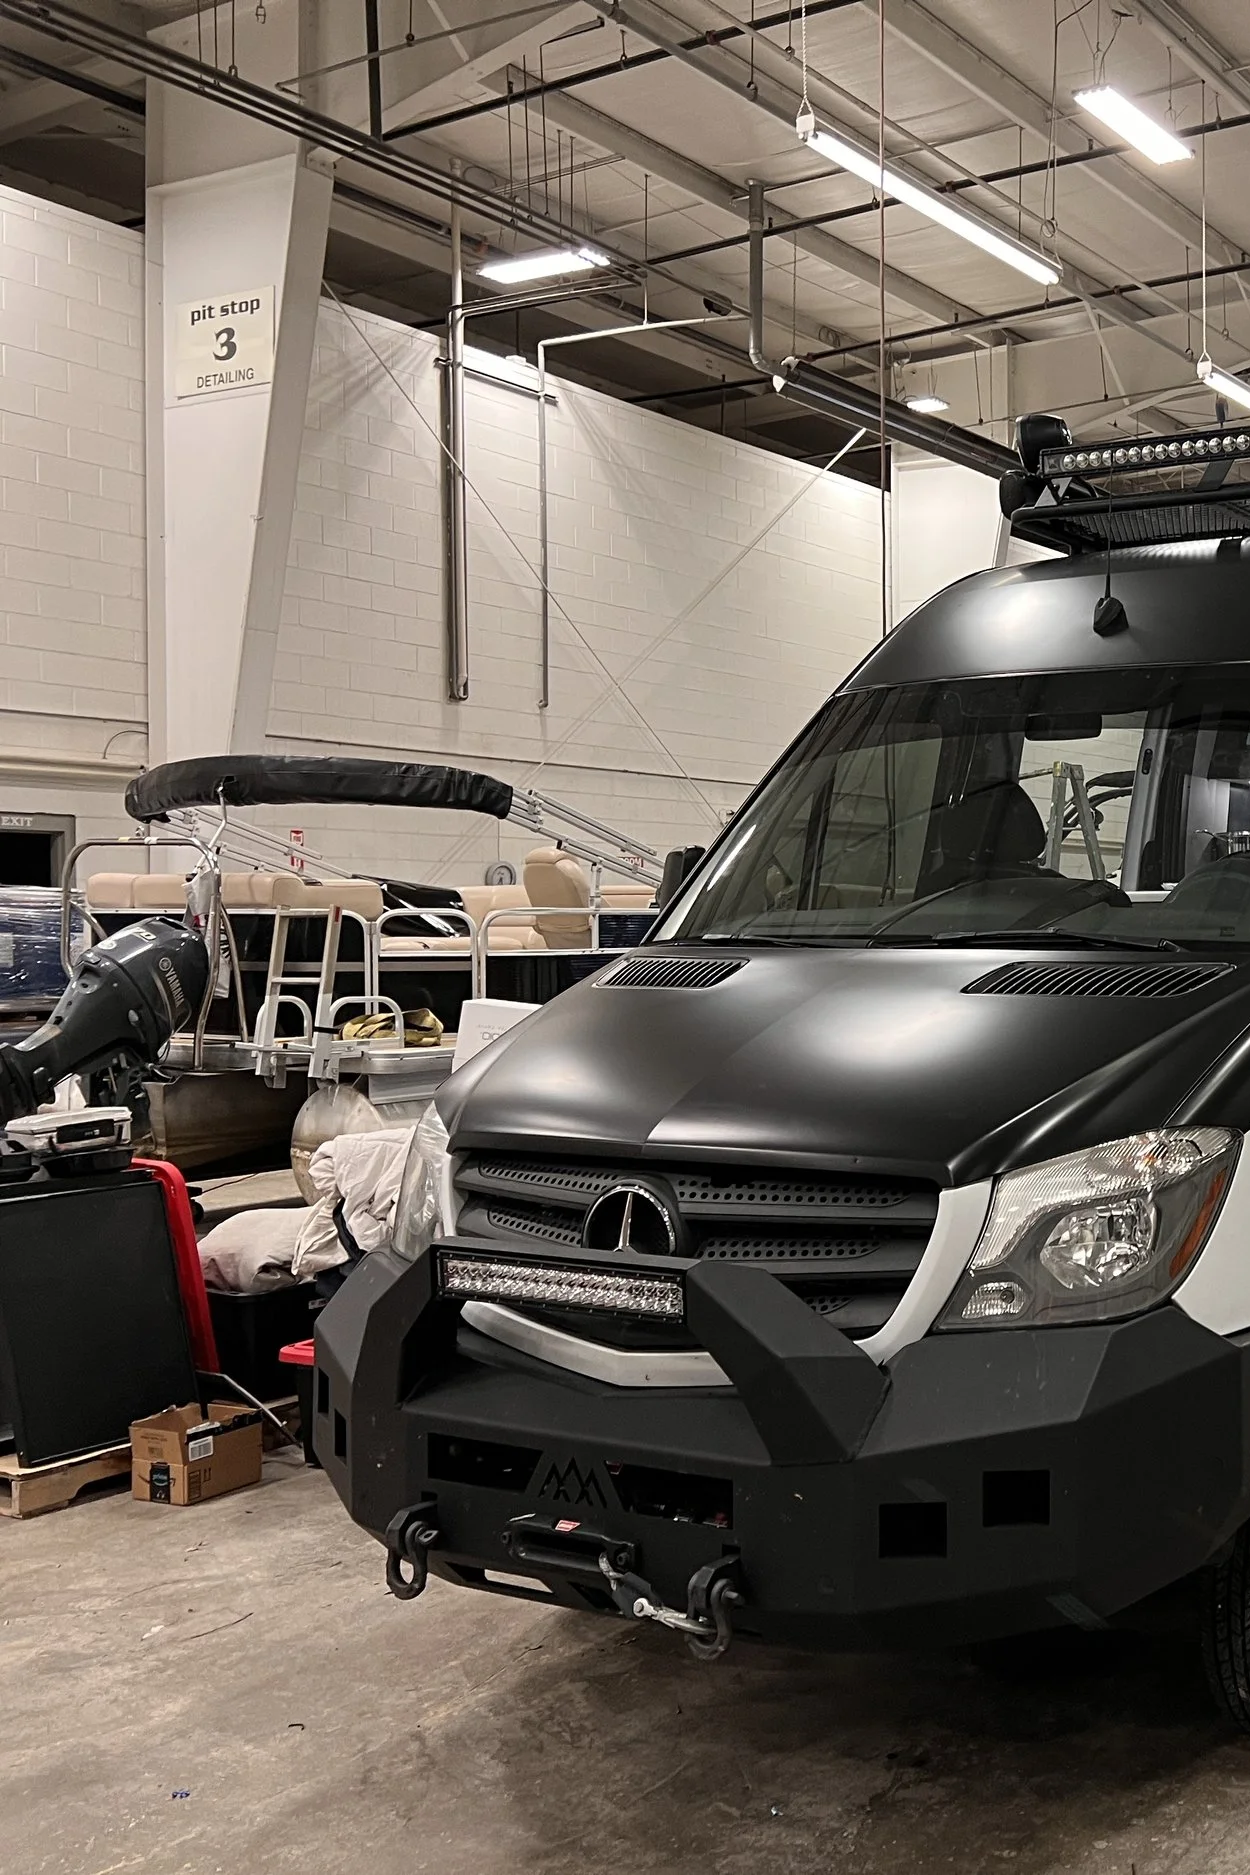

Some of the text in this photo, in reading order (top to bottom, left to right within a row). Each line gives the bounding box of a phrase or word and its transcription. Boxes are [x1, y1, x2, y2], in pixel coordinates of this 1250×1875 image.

[190, 298, 261, 326] pit stop
[212, 327, 238, 361] 3
[196, 367, 254, 389] DETAILING
[1, 815, 33, 827] EXIT
[164, 967, 185, 1009] YAMAHA
